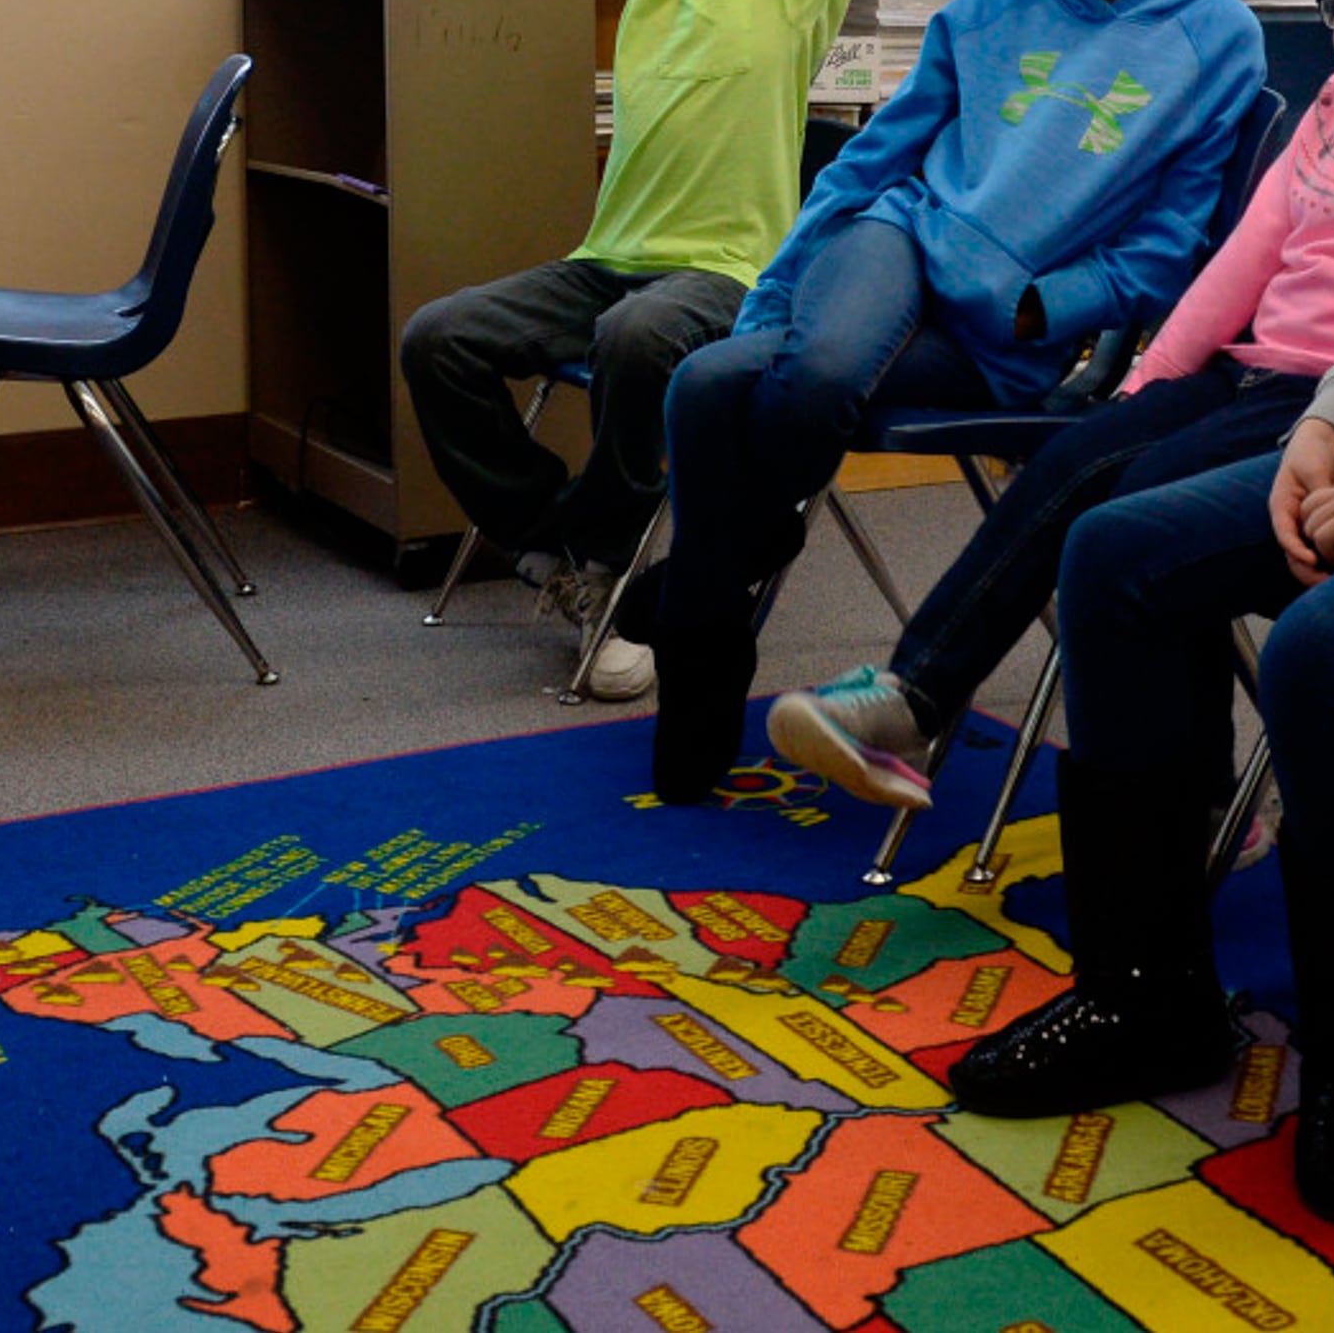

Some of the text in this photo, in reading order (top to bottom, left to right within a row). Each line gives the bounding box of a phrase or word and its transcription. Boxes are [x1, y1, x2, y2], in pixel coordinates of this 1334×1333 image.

[779, 807, 830, 827] W
[952, 966, 1011, 1026] ALABAMA
[655, 1012, 758, 1080] KENTUCKY
[778, 1011, 901, 1088] TENNESSEE
[312, 1104, 411, 1182] MICHIGAN
[539, 1078, 616, 1138] INDIANA
[639, 1137, 719, 1206] ILLINOIS
[1046, 1114, 1113, 1202] ARKANSAS
[840, 1171, 920, 1254] MISSOURI
[355, 1230, 474, 1332] WISCONSIN
[1135, 1228, 1296, 1332] OKLAHOMA
